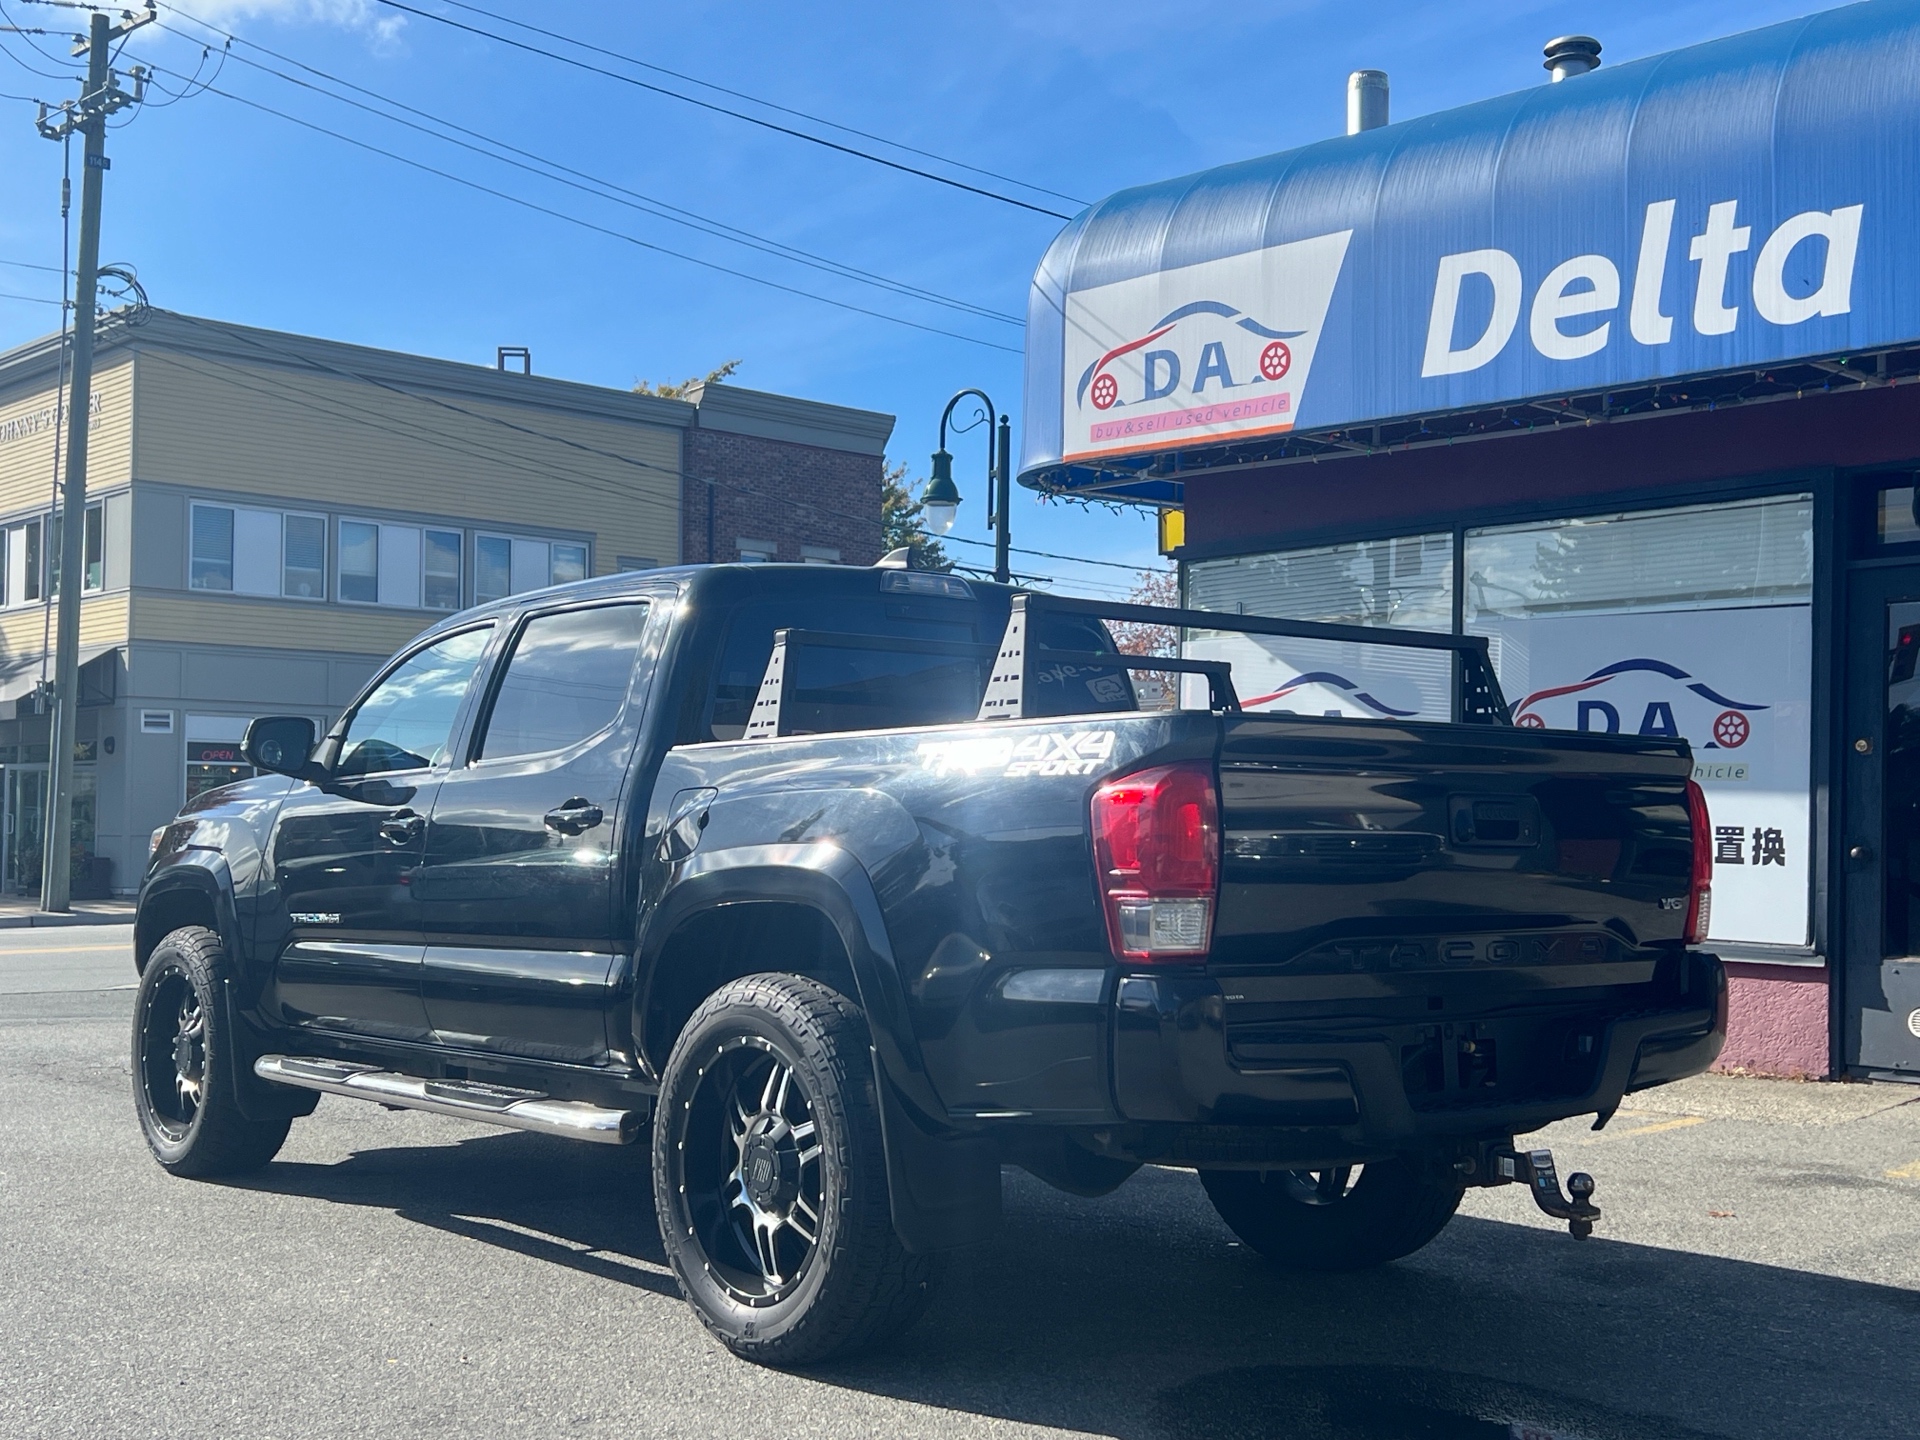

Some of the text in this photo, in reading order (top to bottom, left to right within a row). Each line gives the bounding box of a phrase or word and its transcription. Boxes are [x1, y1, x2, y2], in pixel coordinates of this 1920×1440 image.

[1421, 199, 1864, 378] Delta
[1096, 398, 1287, 439] buy&sell used vehicle
[201, 750, 234, 761] OPEN
[1004, 758, 1106, 777] SPORT
[1693, 765, 1745, 779] hicle
[1714, 826, 1786, 867] 置换
[1660, 897, 1683, 910] V6
[1335, 936, 1607, 970] TACOMA
